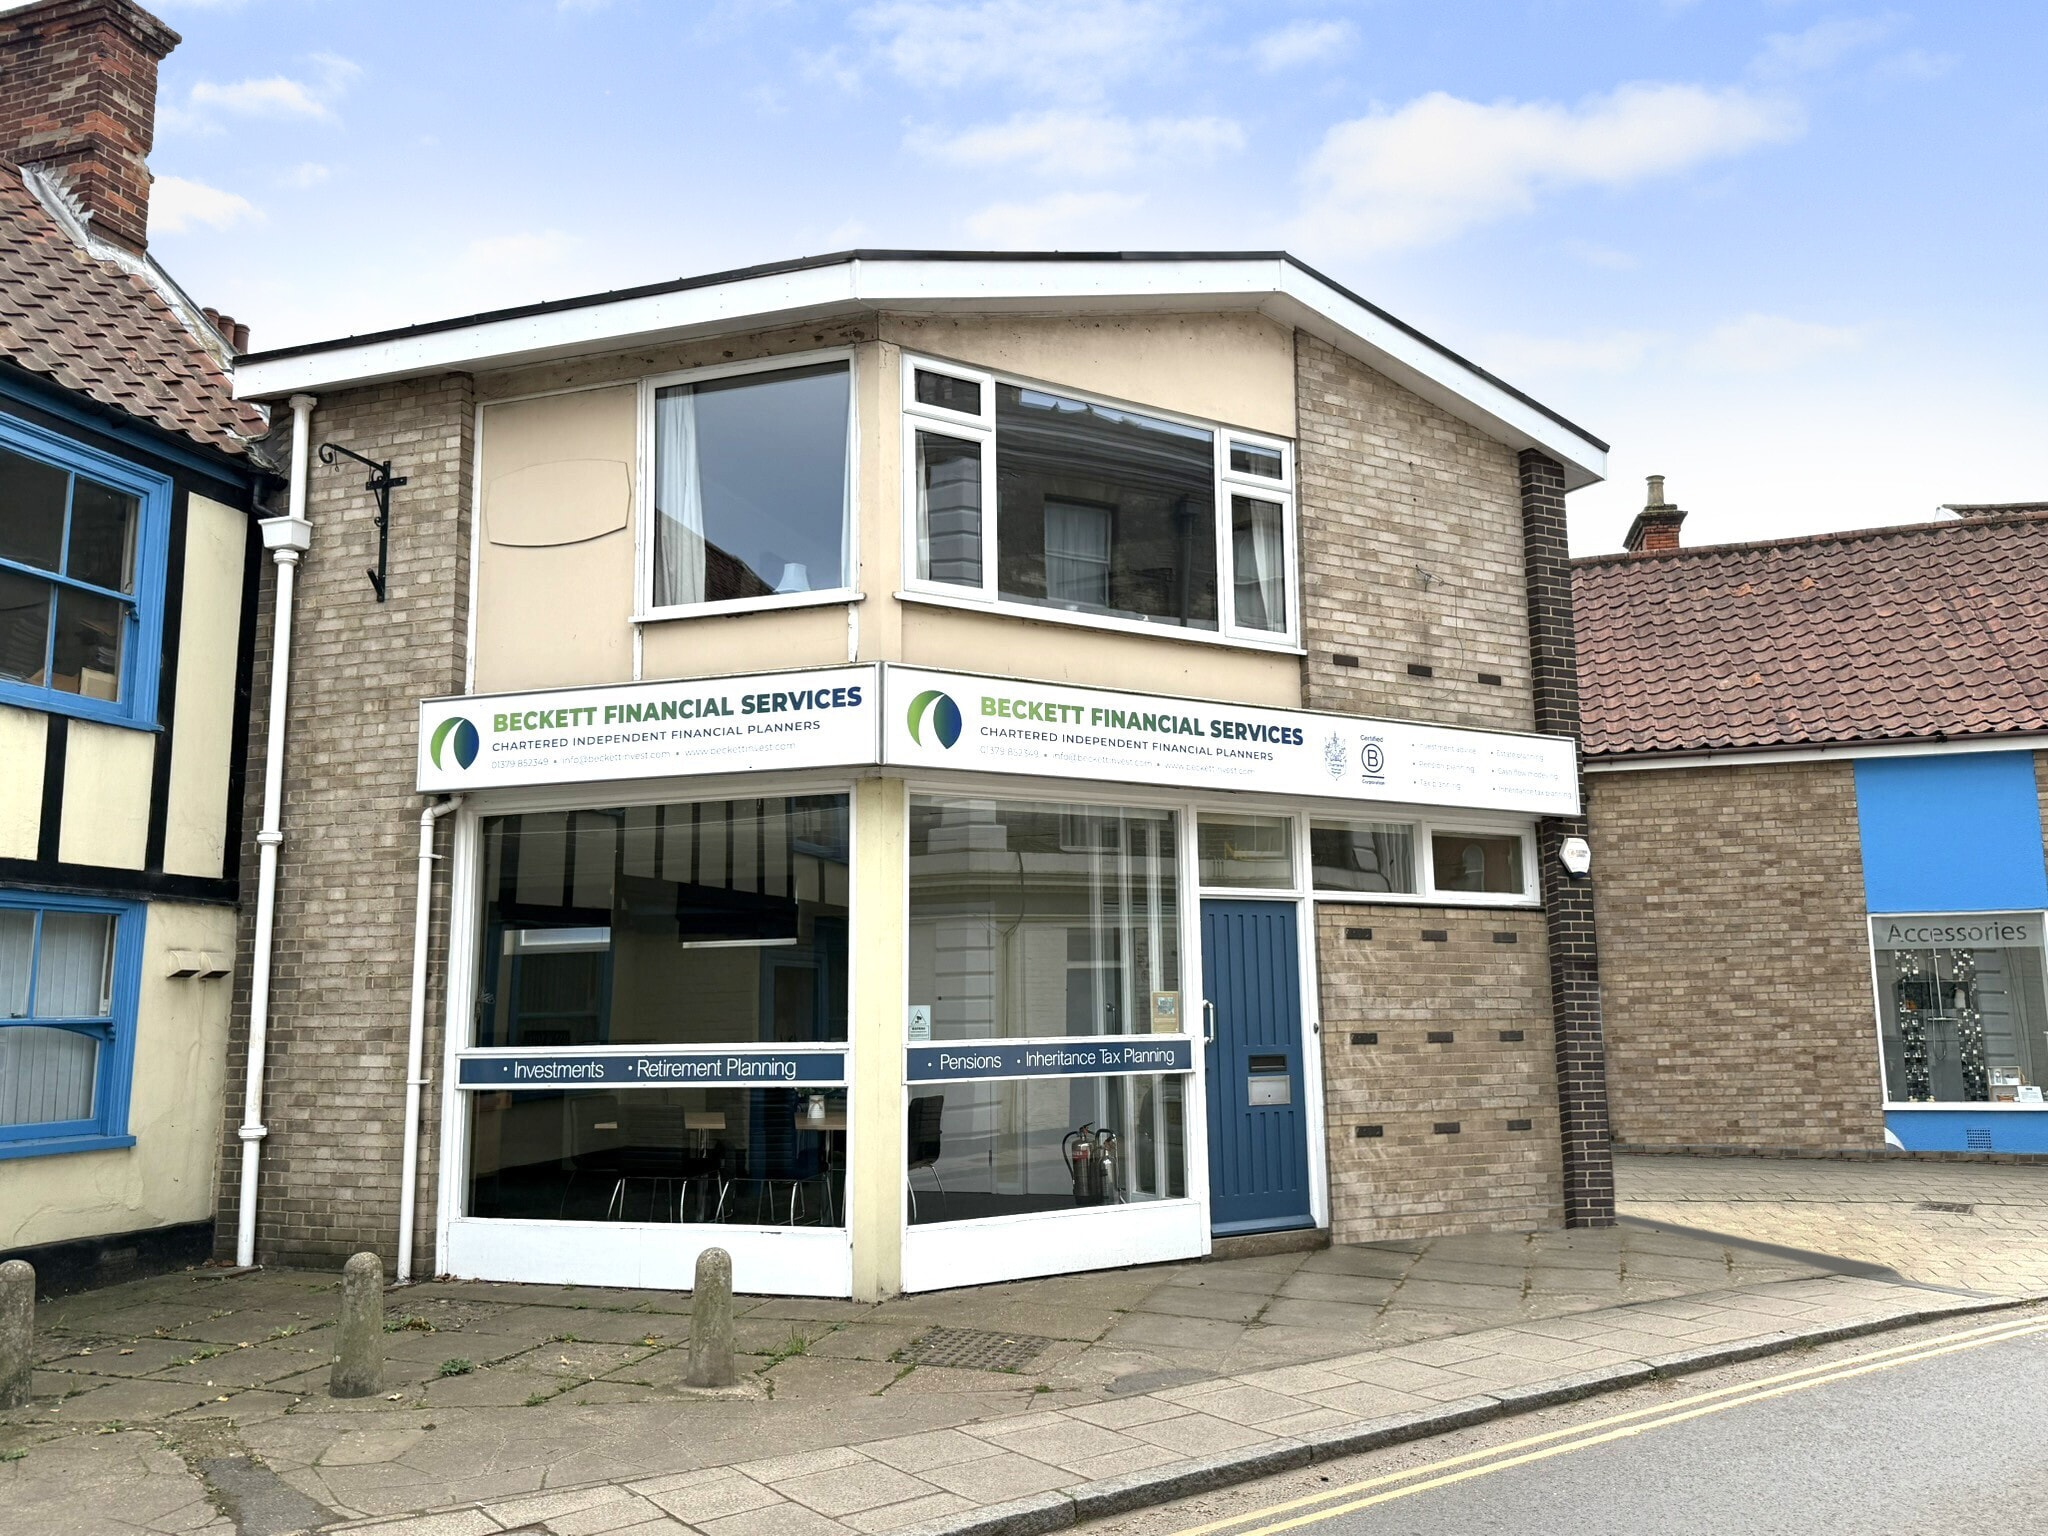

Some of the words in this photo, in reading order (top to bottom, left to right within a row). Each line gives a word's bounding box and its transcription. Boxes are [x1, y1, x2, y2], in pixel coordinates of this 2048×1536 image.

[493, 706, 597, 733] BECKETT
[604, 697, 734, 725] FINANCIAL
[741, 686, 862, 715] SERVICES
[981, 696, 1085, 725] BECKETT
[1091, 708, 1205, 737] FINANCIAL
[1210, 719, 1304, 746] SERVICES
[492, 738, 568, 752] CHARTERED
[573, 731, 667, 746] INDEPENDENT
[671, 726, 743, 740] FINANCIAL
[747, 720, 821, 735] PLANNERS
[980, 726, 1058, 742] CHARTERED
[1062, 735, 1148, 750] INDEPENDENT
[1152, 742, 1213, 756] FINANCIAL
[1216, 748, 1274, 761] PLANNERS
[1360, 734, 1384, 743] Certified
[491, 760, 515, 769] 01379
[562, 751, 671, 765] info@beckettnvest.com
[1367, 749, 1379, 767] B
[1887, 921, 2027, 942] Accessories
[514, 1061, 604, 1079] Investments
[637, 1059, 722, 1078] Retirement
[726, 1057, 797, 1081] Planning
[940, 1054, 1002, 1071] Pensions
[1026, 1050, 1096, 1067] Inheritance
[1100, 1049, 1121, 1064] Tax
[1124, 1047, 1175, 1066] Planning
